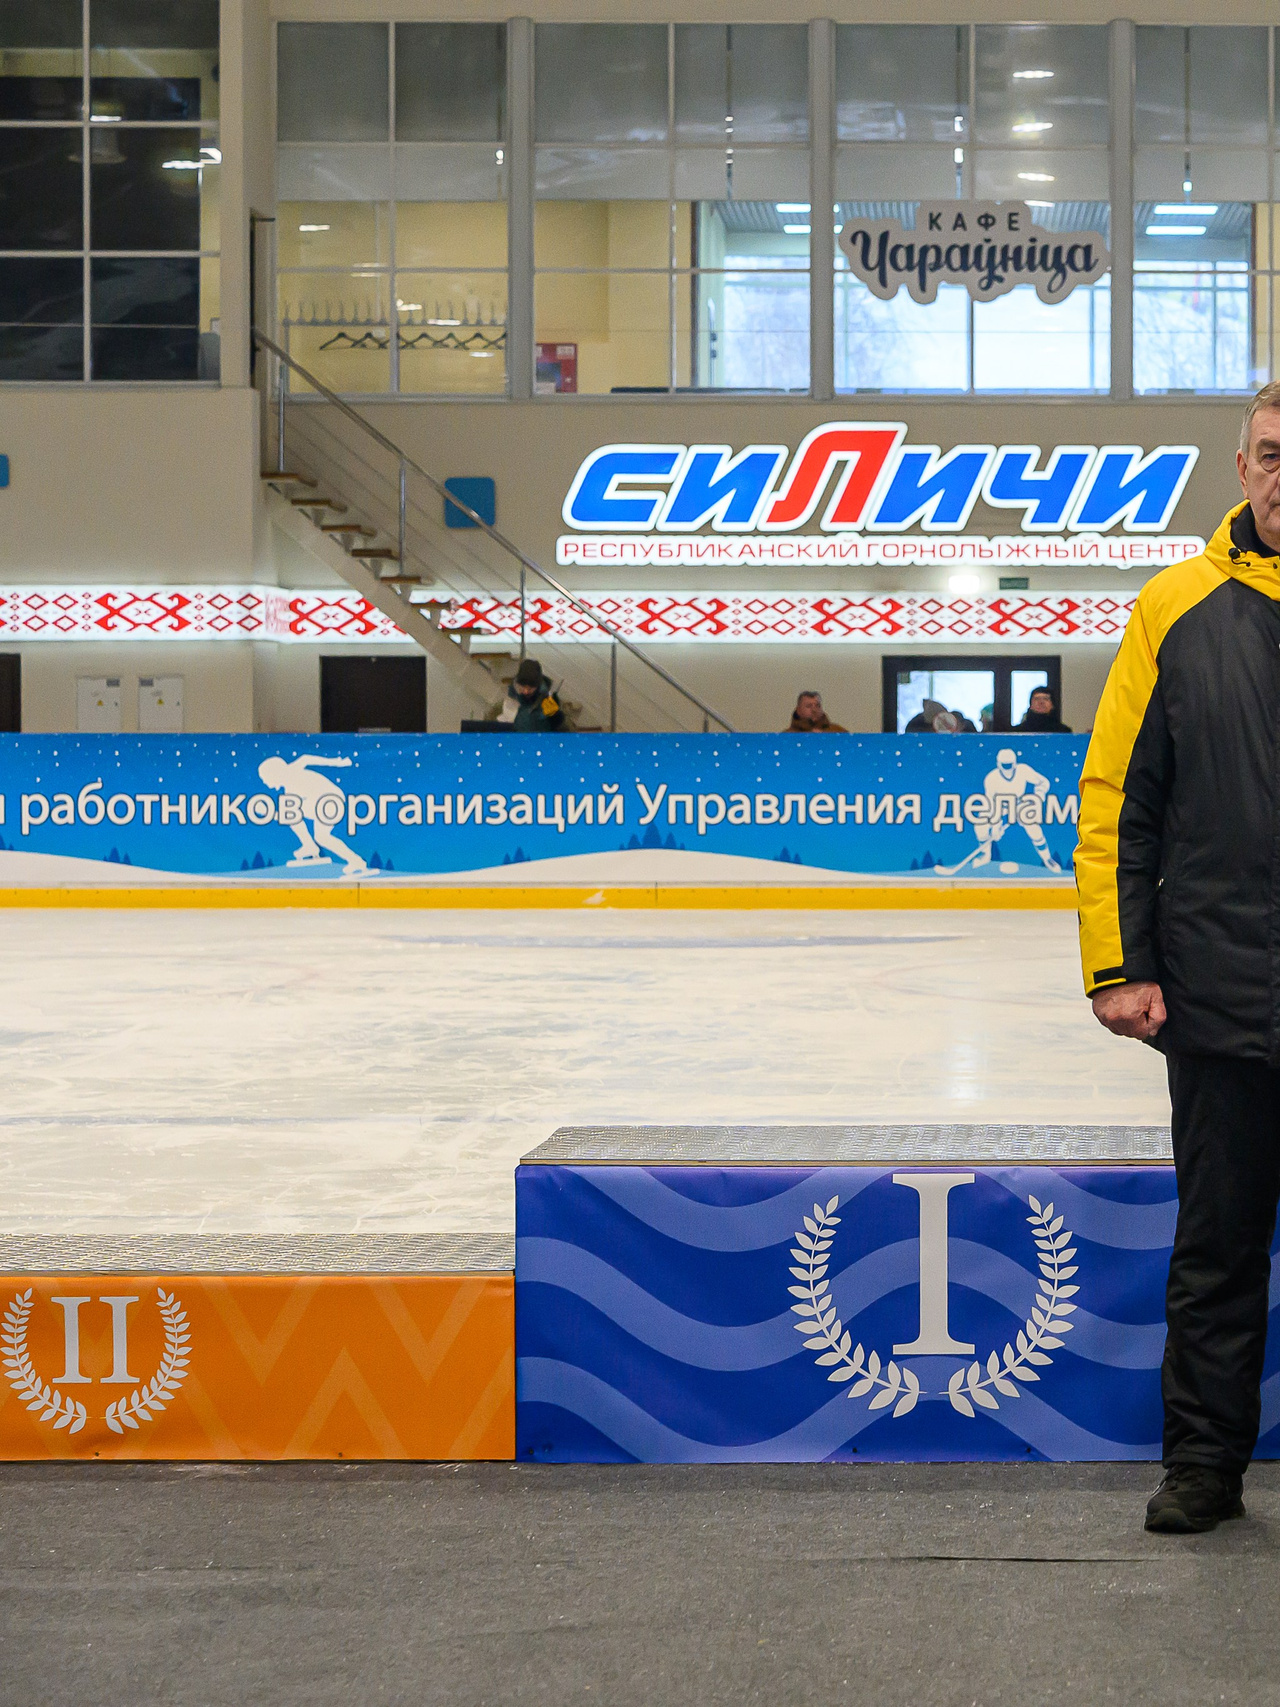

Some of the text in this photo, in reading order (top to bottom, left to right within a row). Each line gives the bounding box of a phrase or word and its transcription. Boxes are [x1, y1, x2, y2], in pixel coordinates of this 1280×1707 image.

[928, 212, 1020, 231] КАФЕ
[850, 228, 1099, 293] Чараўніца
[564, 538, 1198, 562] РЕСПУБЛИКАНСКИЙ ГОРНОЛЫЖНЫЙ ЦЕНТР
[21, 782, 304, 837] работников
[314, 782, 625, 836] организаций
[636, 782, 922, 835] Управления
[51, 1296, 140, 1384] II
